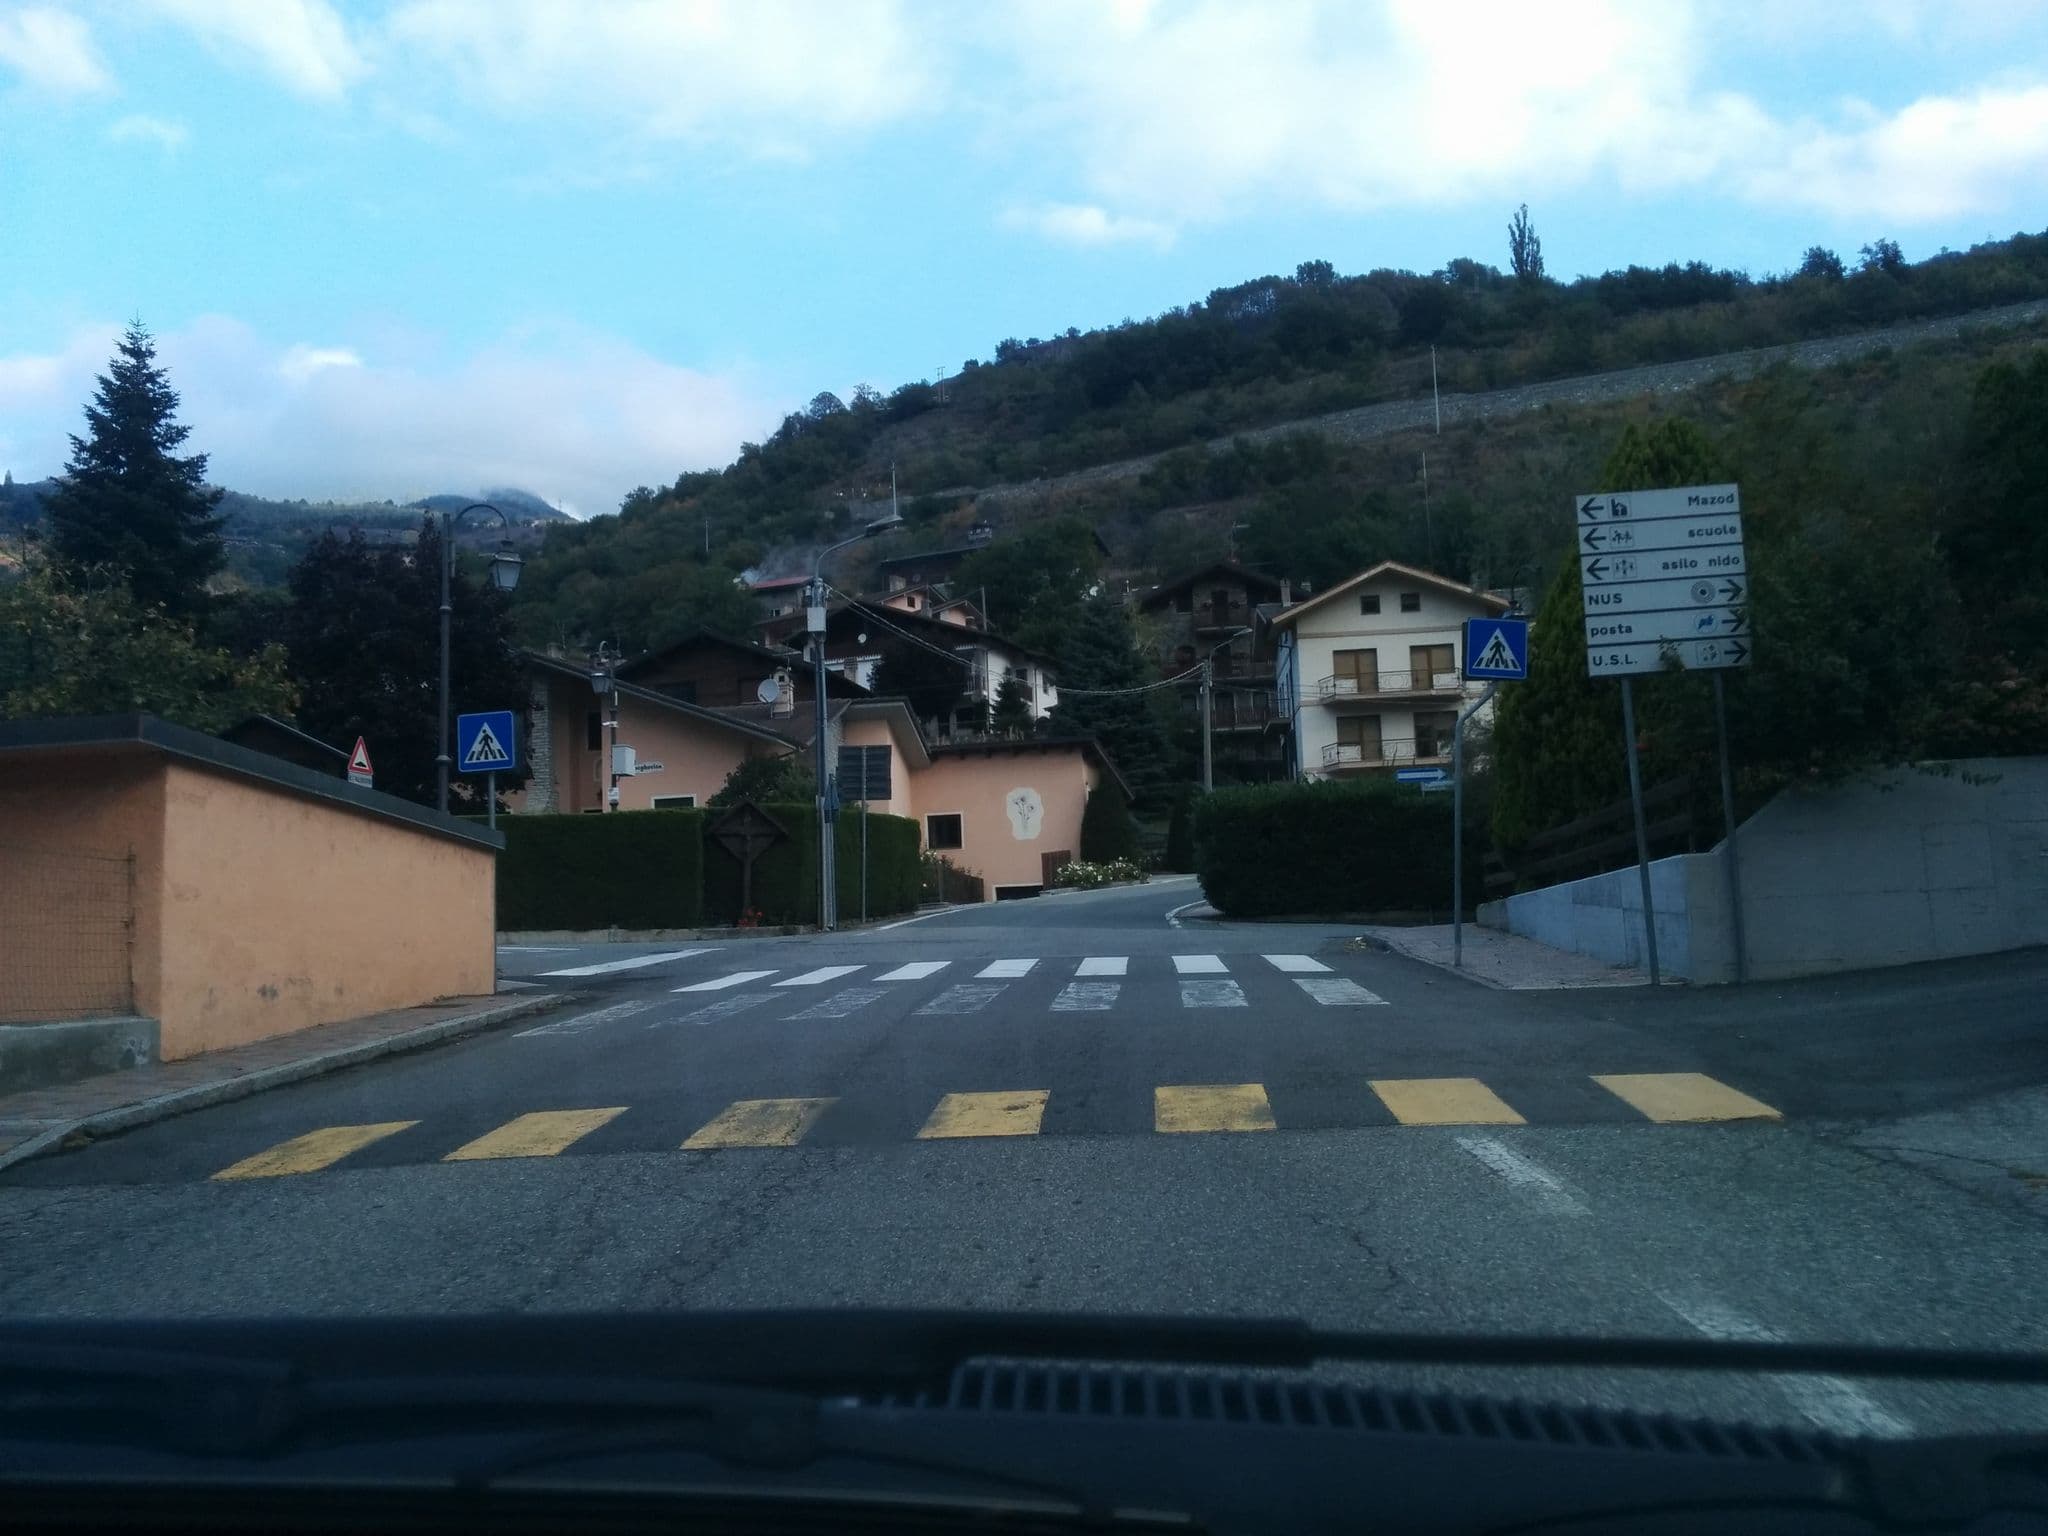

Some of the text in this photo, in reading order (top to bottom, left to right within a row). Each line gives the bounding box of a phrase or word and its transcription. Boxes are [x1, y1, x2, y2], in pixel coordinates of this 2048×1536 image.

[1688, 493, 1735, 507] Mazod
[1688, 525, 1737, 538] scuole
[1662, 554, 1740, 571] asilo nido
[1588, 593, 1623, 606] NUS
[1590, 623, 1633, 638] posta
[1592, 653, 1639, 667] U.S.L.
